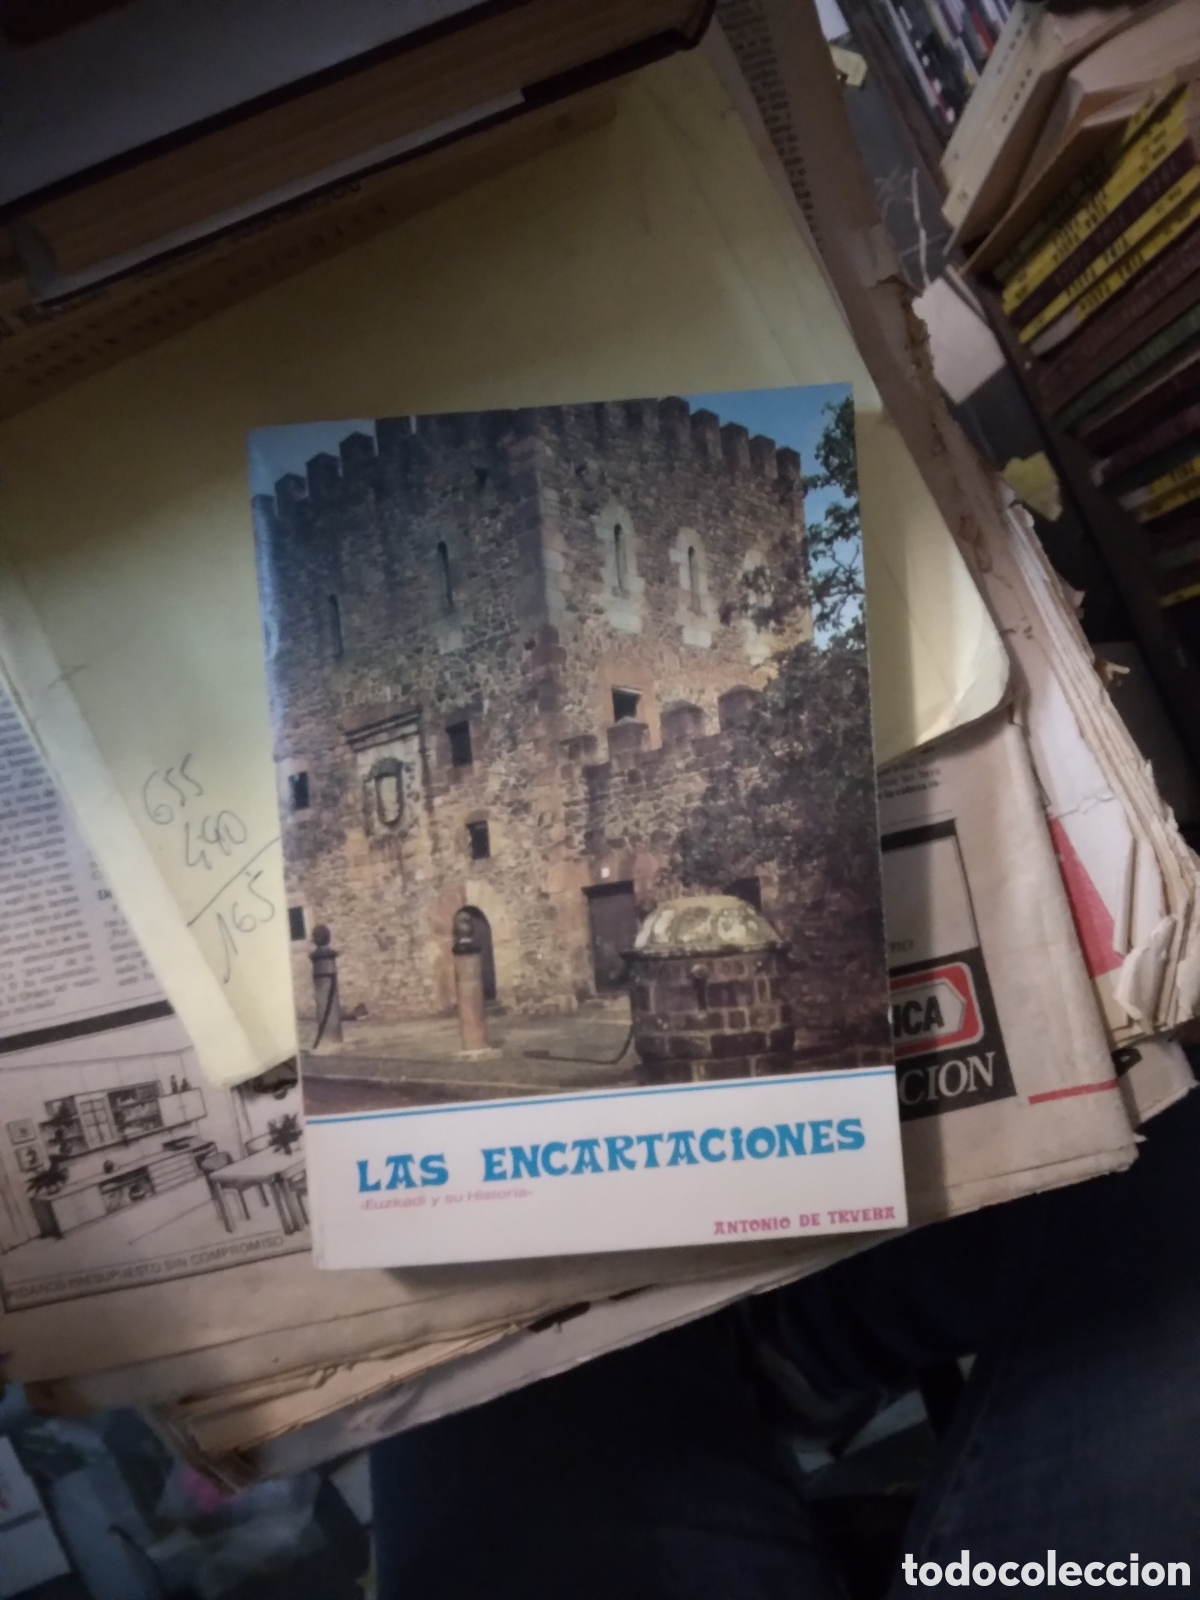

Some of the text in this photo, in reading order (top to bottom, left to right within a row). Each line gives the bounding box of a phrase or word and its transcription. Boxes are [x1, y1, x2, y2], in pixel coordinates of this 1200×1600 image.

[143, 753, 204, 825] 655
[357, 1154, 450, 1193] LAS
[430, 1196, 442, 1208] y
[445, 1193, 465, 1205] su
[713, 1216, 792, 1236] ANTONIO
[798, 1212, 821, 1228] DE
[164, 1256, 188, 1273] SIN
[190, 1234, 285, 1267] COMPROMISO
